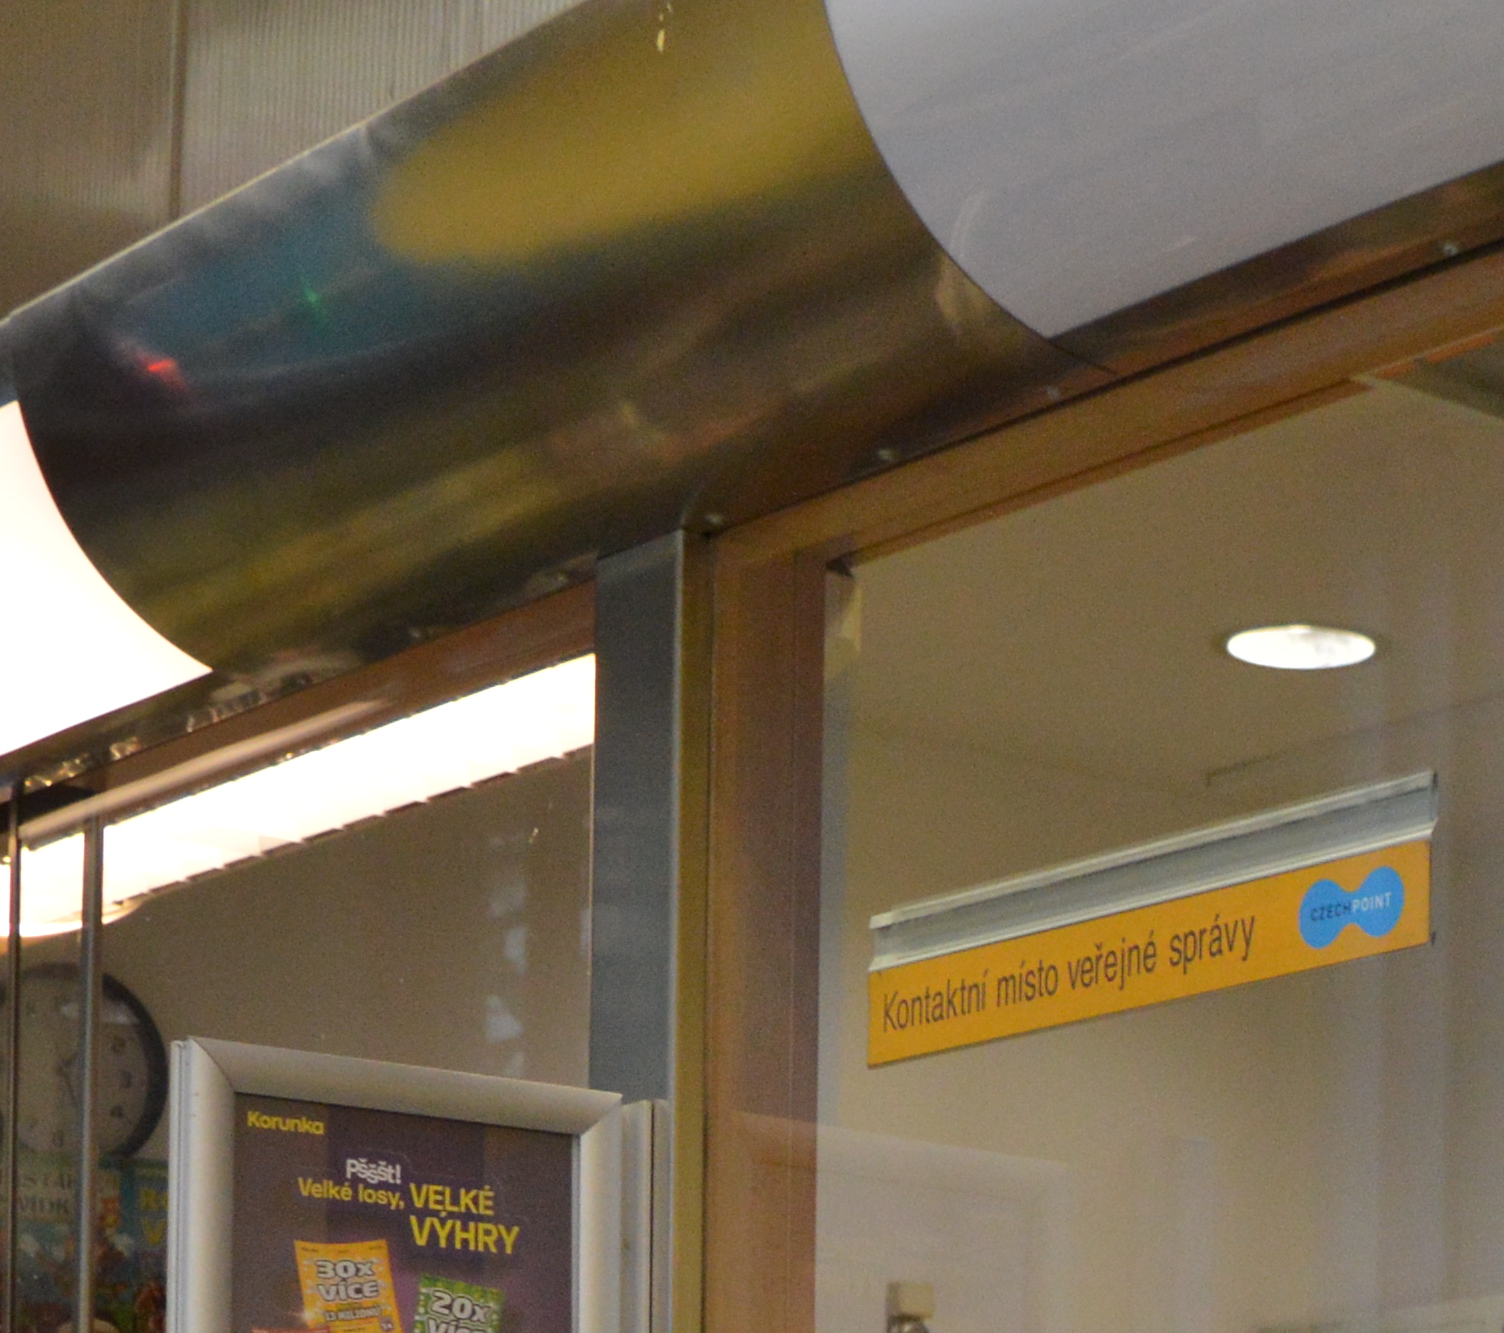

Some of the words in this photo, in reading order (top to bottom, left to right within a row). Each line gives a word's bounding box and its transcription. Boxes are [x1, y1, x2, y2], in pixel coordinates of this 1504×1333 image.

[883, 969, 989, 1033] Kontaktní
[996, 961, 1058, 1008] místo
[1068, 929, 1158, 992] veřejné
[1169, 913, 1255, 978] správy
[247, 1111, 325, 1136] Korunka
[298, 1177, 352, 1201] Velké
[358, 1183, 404, 1210] losy,
[409, 1184, 495, 1216] VELKÉ
[409, 1211, 520, 1254] VÝHRY
[315, 1259, 375, 1279] 30x
[317, 1279, 380, 1302] VÍCE
[431, 1291, 490, 1323] 20x
